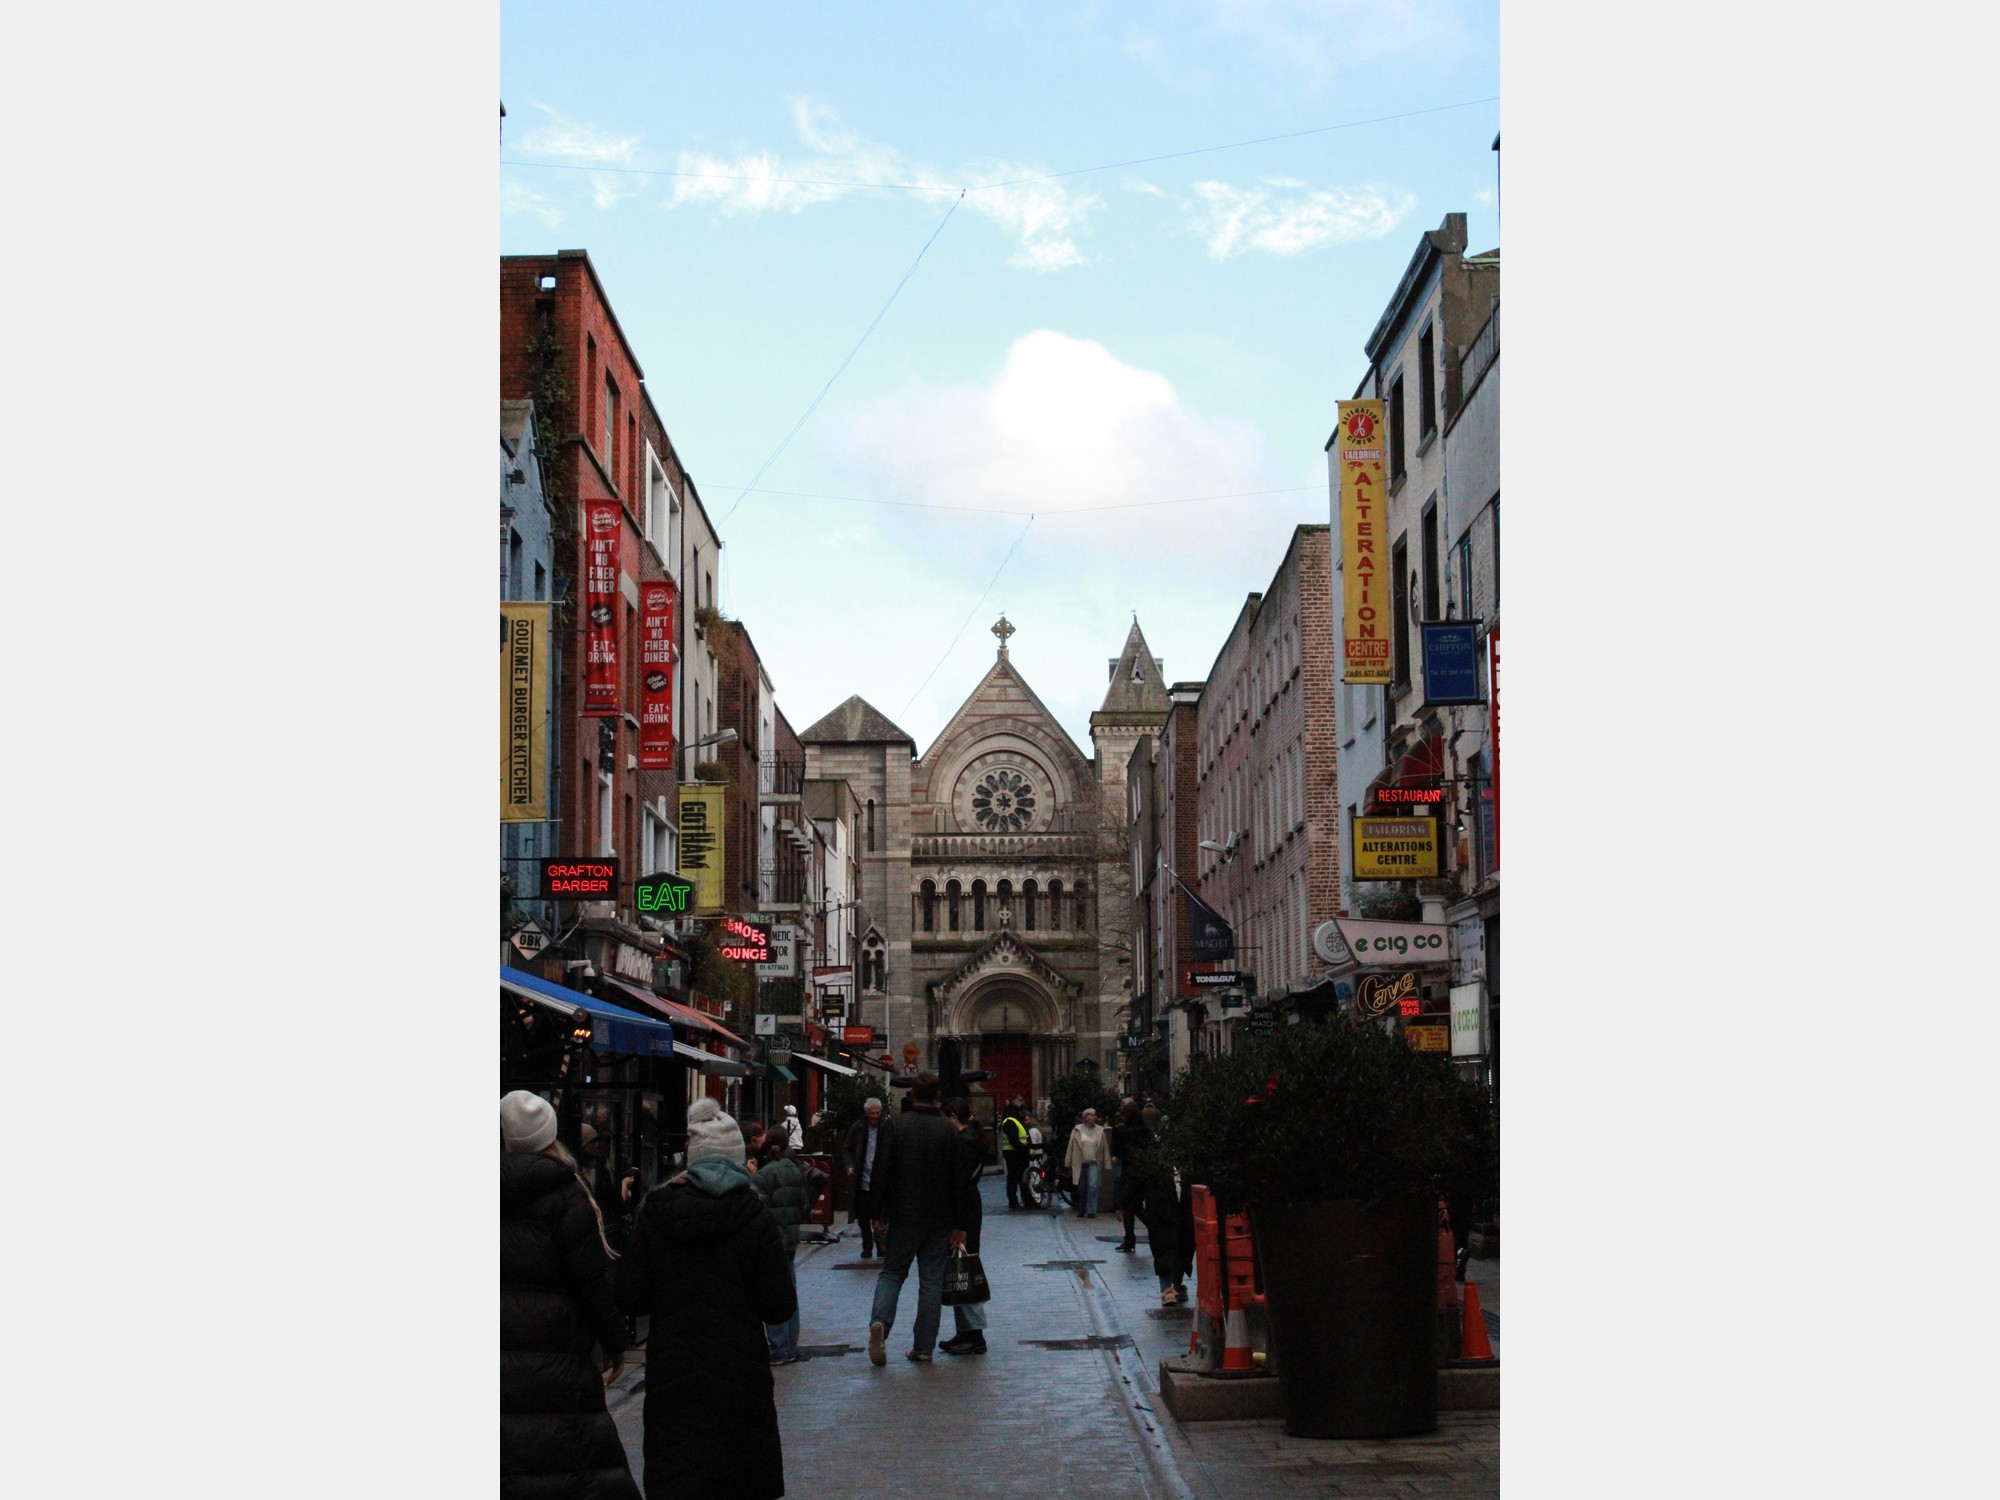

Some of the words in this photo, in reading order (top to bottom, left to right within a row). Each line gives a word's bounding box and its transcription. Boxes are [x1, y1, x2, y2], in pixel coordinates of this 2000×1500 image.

[1344, 450, 1381, 460] TAILORING
[590, 539, 615, 552] AIN'T
[595, 552, 608, 566] NO
[1354, 472, 1376, 637] ALTERATION
[589, 566, 615, 579] FINER
[589, 580, 615, 593] DINER
[646, 616, 668, 628] AIN'T
[652, 628, 663, 639] NO
[514, 619, 529, 683] GOURMET
[593, 640, 609, 652] EAT
[644, 640, 669, 651] FINER
[1348, 641, 1386, 657] CENTRE
[588, 652, 616, 663] DRINK
[644, 652, 670, 663] DINER
[514, 688, 528, 740] BURGER
[648, 703, 665, 714] EAT
[643, 713, 669, 723] DRINK
[513, 745, 528, 804] KITCHEN
[1378, 789, 1442, 803] RESTAURANT
[681, 802, 717, 869] GOTHAM
[1367, 824, 1425, 835] TAILORING
[1362, 841, 1433, 852] ALTERATIONS
[1377, 854, 1418, 865] CENTRE
[547, 865, 614, 877] GRAFTON
[552, 880, 609, 892] BARBER
[637, 882, 691, 911] EAT
[519, 934, 542, 947] GBK
[772, 930, 791, 942] METIC
[1355, 938, 1368, 952] e
[1414, 934, 1442, 949] co
[717, 947, 767, 960] OUNGE
[1195, 975, 1237, 984] TONI&GUY
[1357, 972, 1415, 1016] Cave
[1399, 999, 1419, 1007] WINE
[1400, 1007, 1420, 1016] BAR
[1251, 1020, 1277, 1028] WATCH
